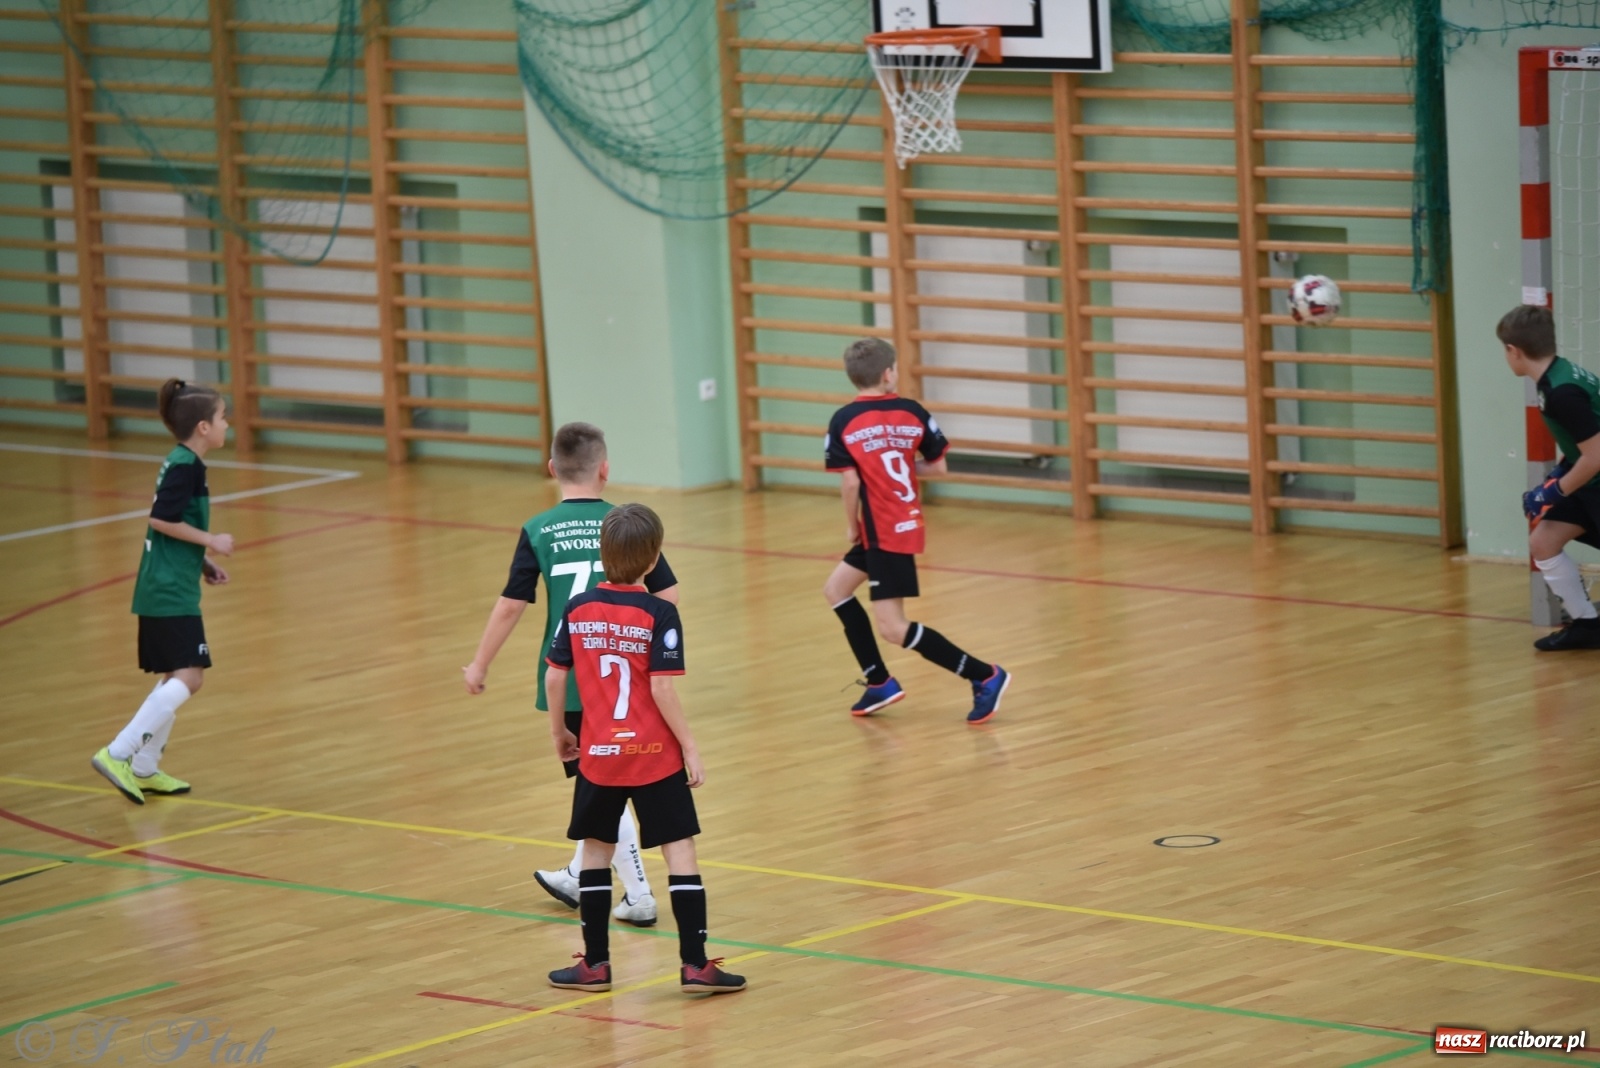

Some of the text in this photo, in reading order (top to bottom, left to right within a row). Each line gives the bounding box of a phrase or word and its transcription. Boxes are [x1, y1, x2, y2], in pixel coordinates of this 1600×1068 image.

[880, 449, 916, 503] 9
[540, 520, 585, 535] AKADEMIA
[599, 654, 632, 721] 7
[588, 742, 663, 756] GER-BUD
